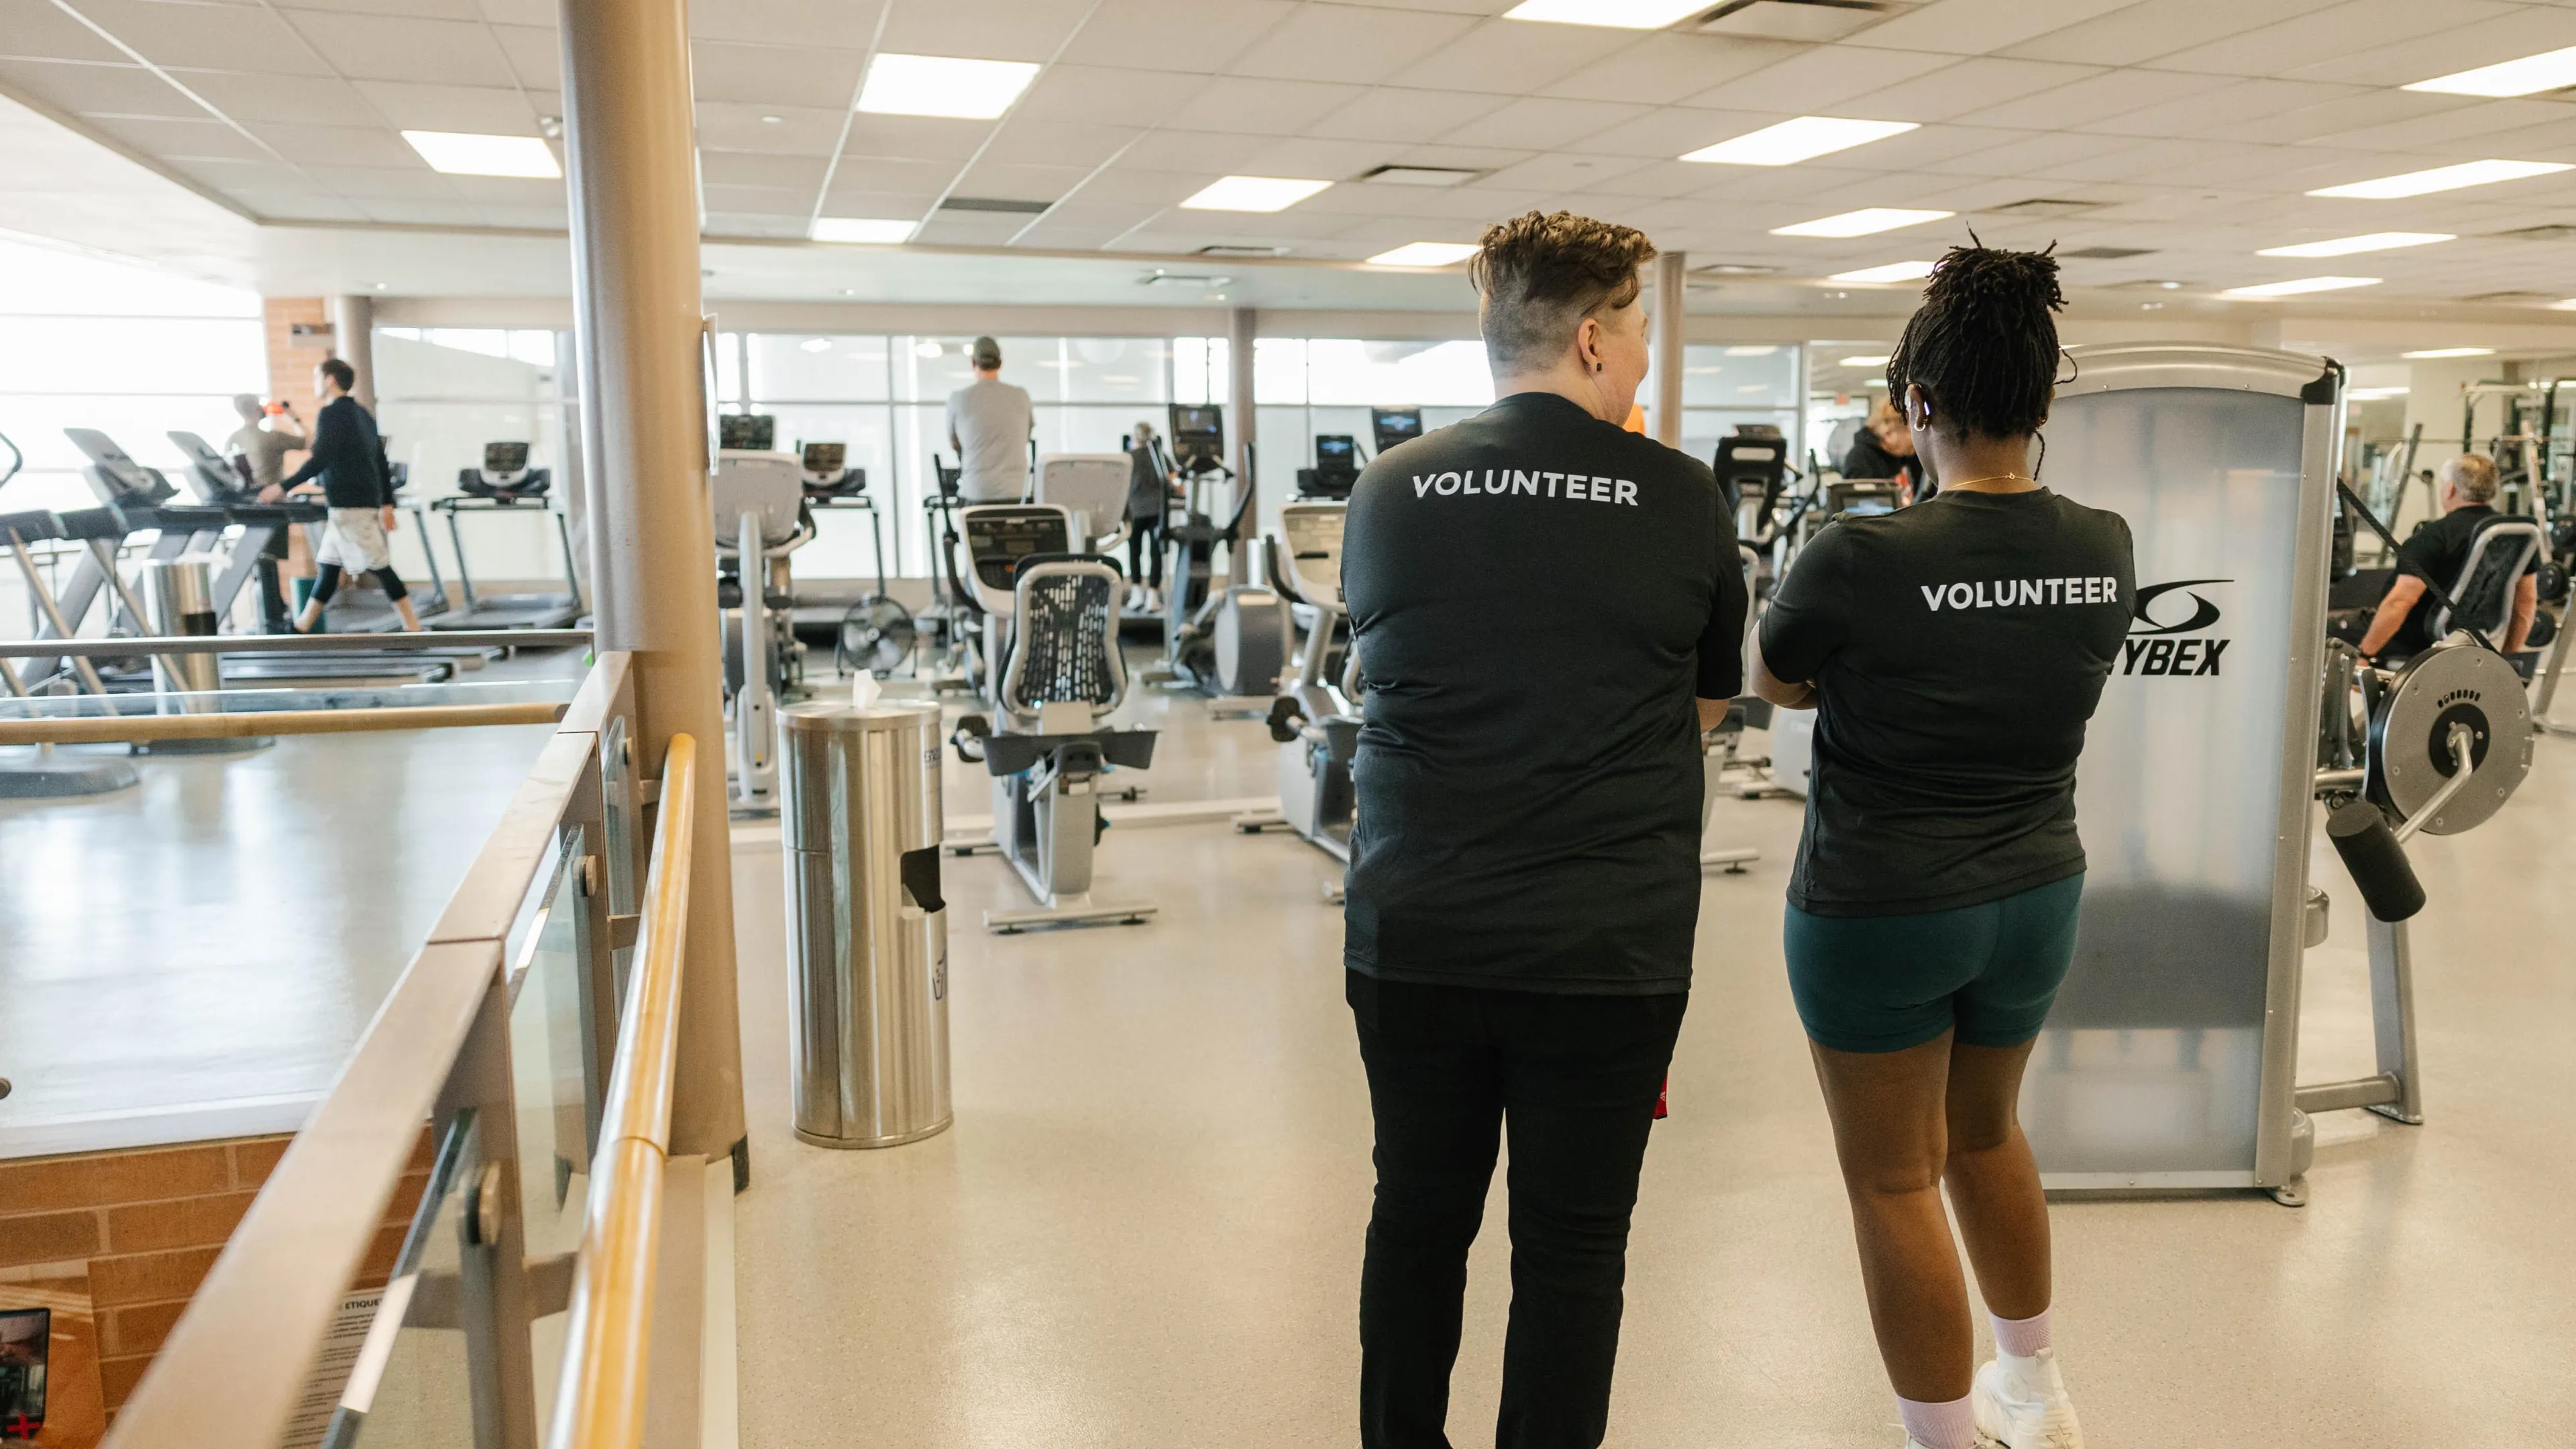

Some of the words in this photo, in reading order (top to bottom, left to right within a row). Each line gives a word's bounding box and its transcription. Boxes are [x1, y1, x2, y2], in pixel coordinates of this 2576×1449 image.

[1412, 469, 1638, 506] VOLUNTEER
[1921, 576, 2117, 611] VOLUNTEER
[2106, 639, 2231, 676] YBEX
[345, 1298, 382, 1310] ETIQUE
